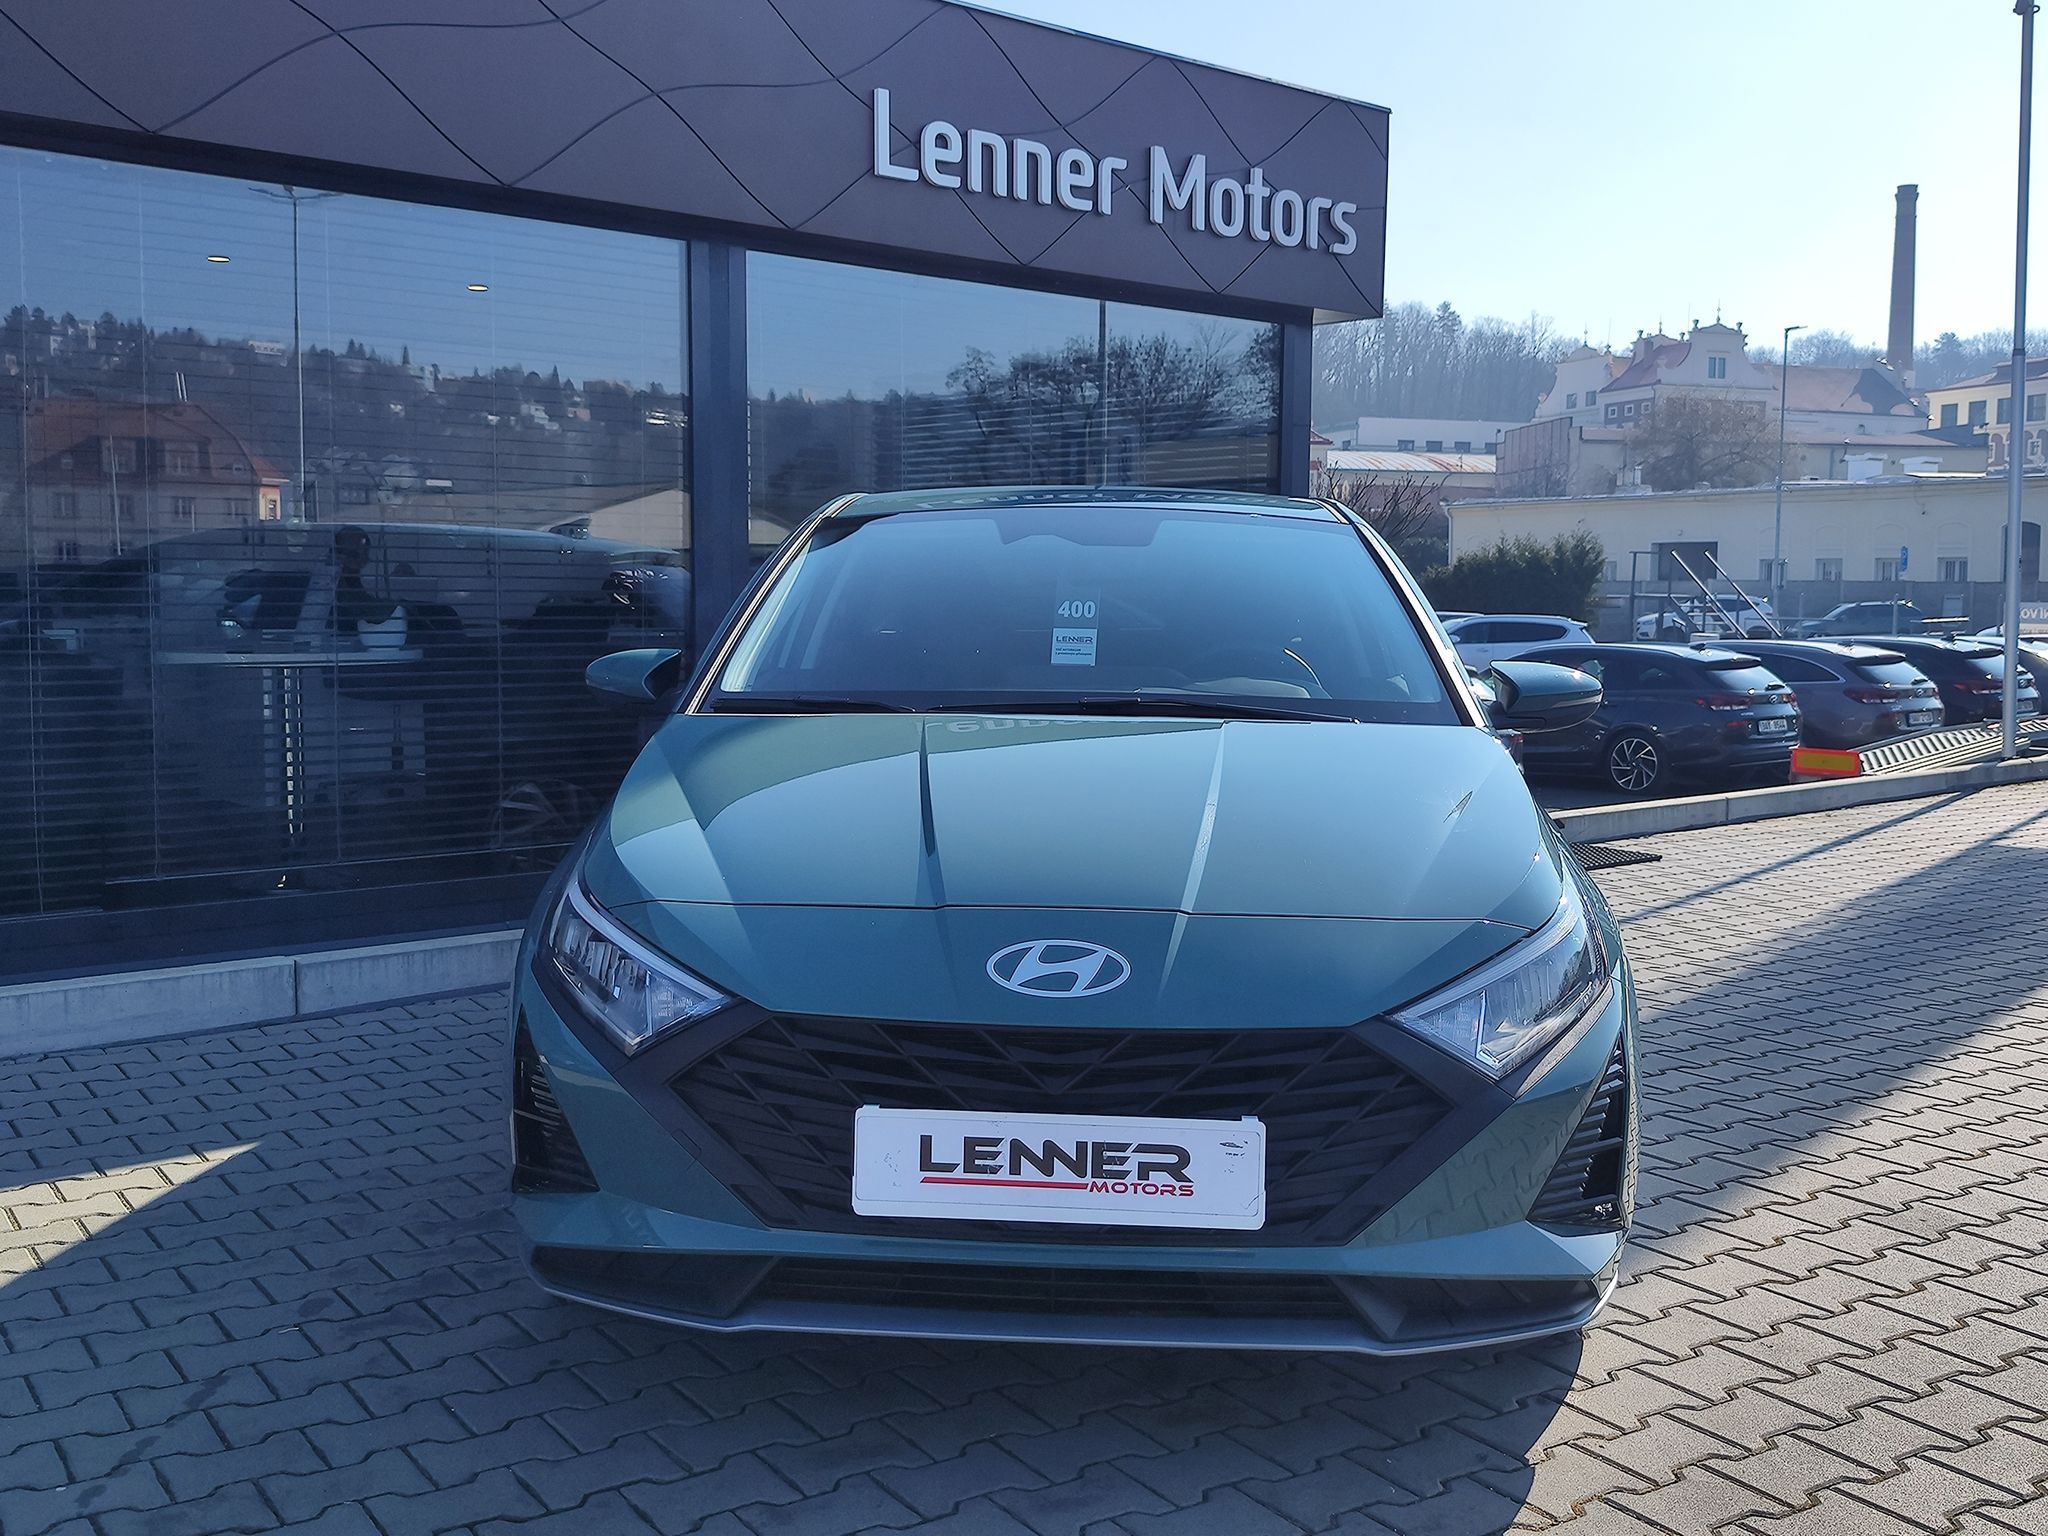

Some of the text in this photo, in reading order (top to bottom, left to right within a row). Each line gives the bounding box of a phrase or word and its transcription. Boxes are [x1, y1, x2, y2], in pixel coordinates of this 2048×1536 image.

[873, 87, 1359, 256] Lenner Motors
[1057, 600, 1096, 618] 400
[1056, 635, 1093, 643] LENNER
[919, 1134, 1194, 1183] LENNER
[1087, 1181, 1195, 1197] MOTORS
